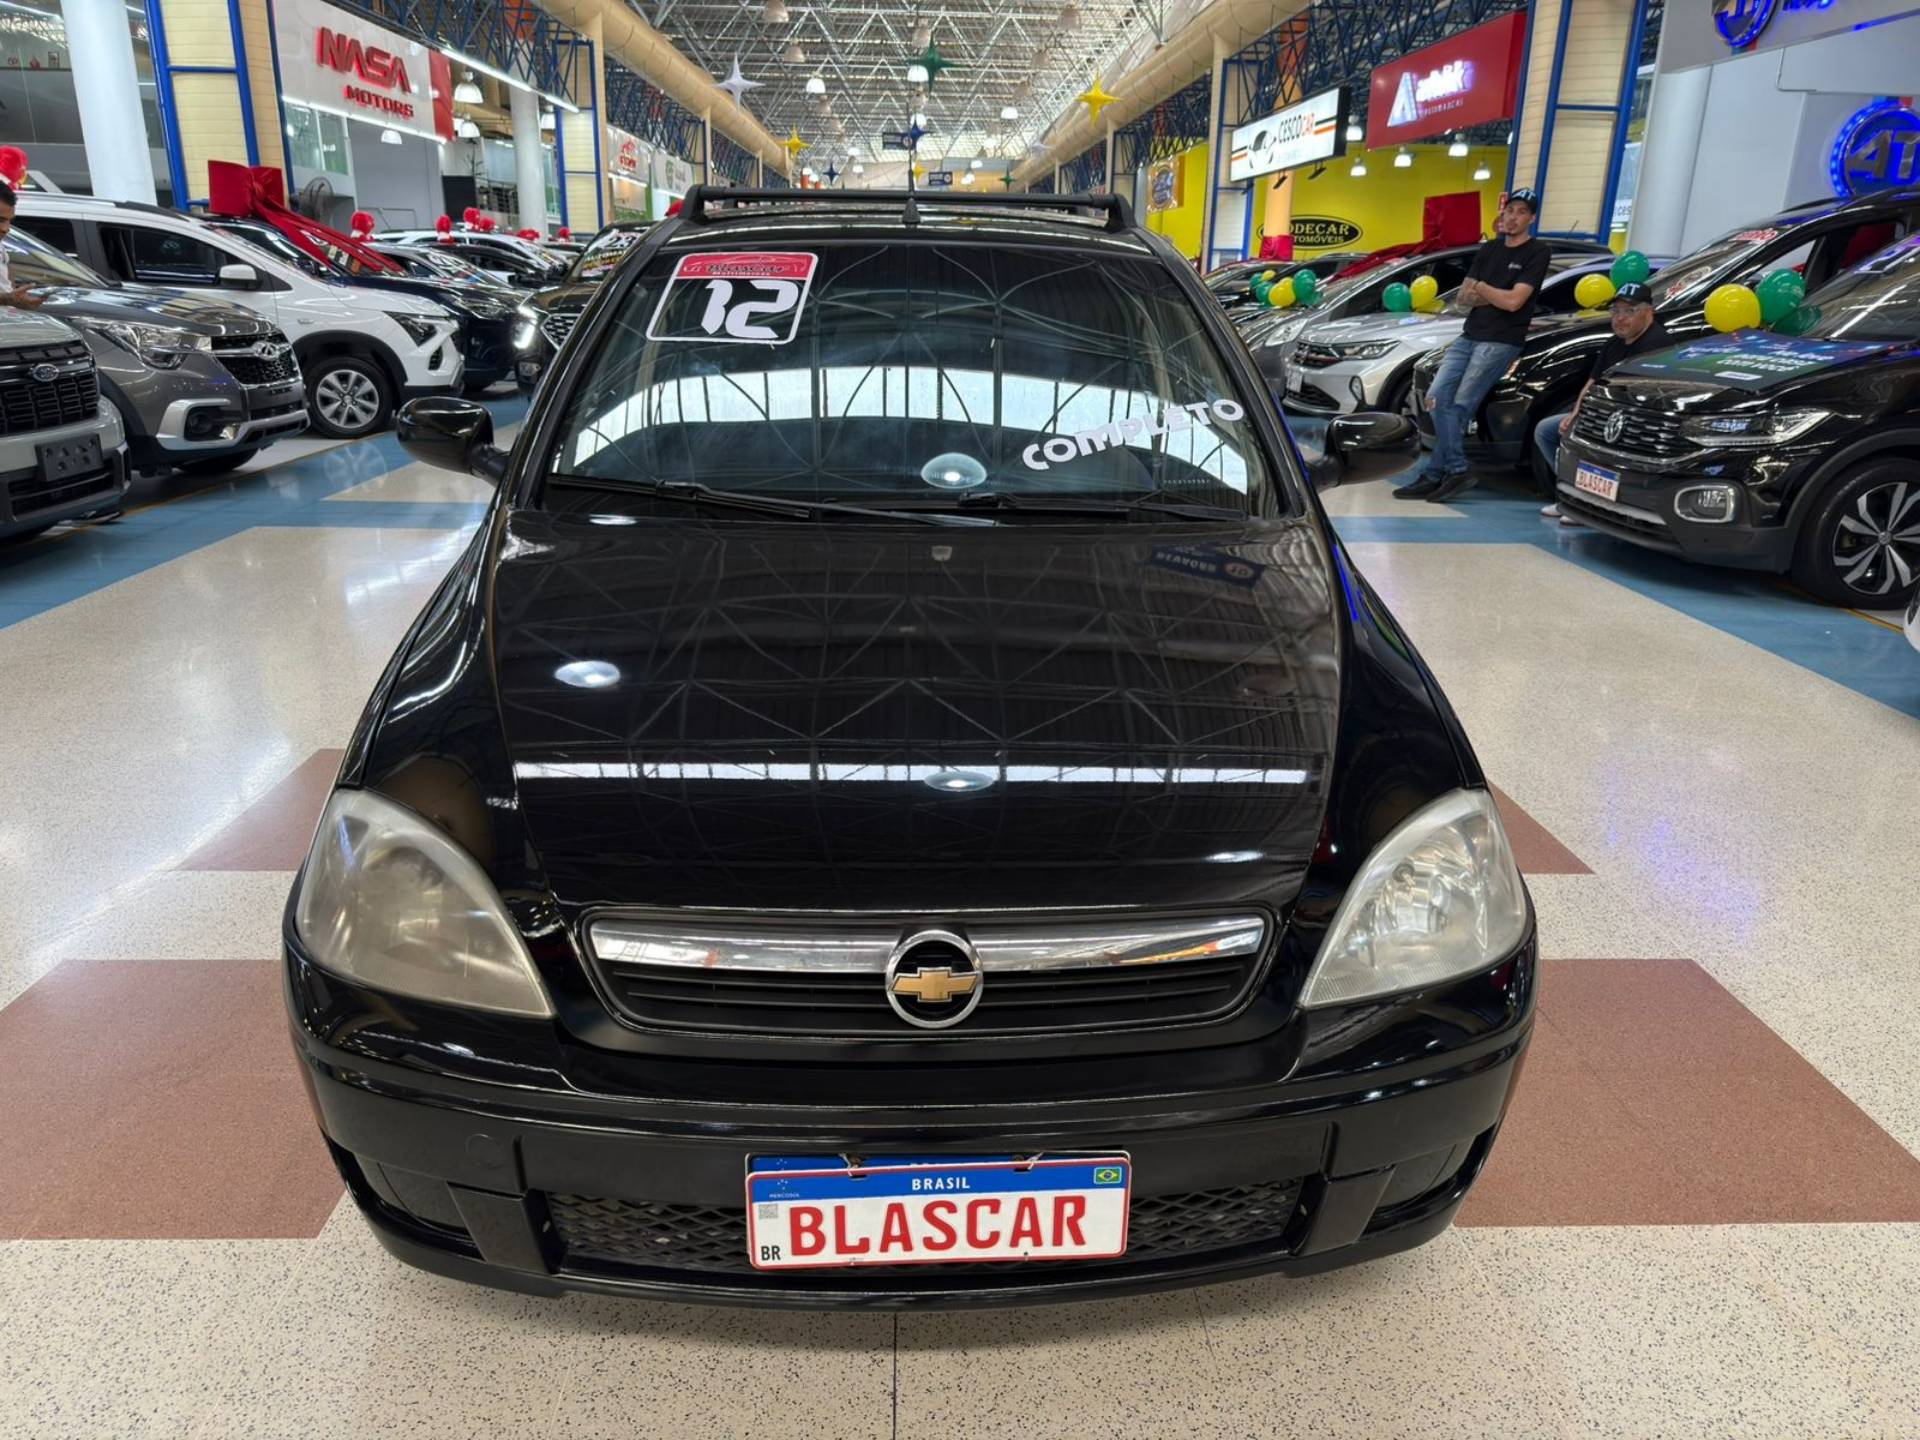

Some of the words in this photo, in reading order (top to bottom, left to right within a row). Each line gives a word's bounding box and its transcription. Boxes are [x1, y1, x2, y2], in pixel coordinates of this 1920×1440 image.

[317, 26, 412, 94] NASA
[345, 84, 414, 119] MOTORS
[701, 279, 799, 339] 12
[1616, 283, 1641, 298] AT
[1022, 399, 1244, 470] COMPLETO
[911, 1177, 971, 1190] BRASIL
[789, 1195, 1086, 1256] BLASCAR
[760, 1245, 781, 1261] BR
